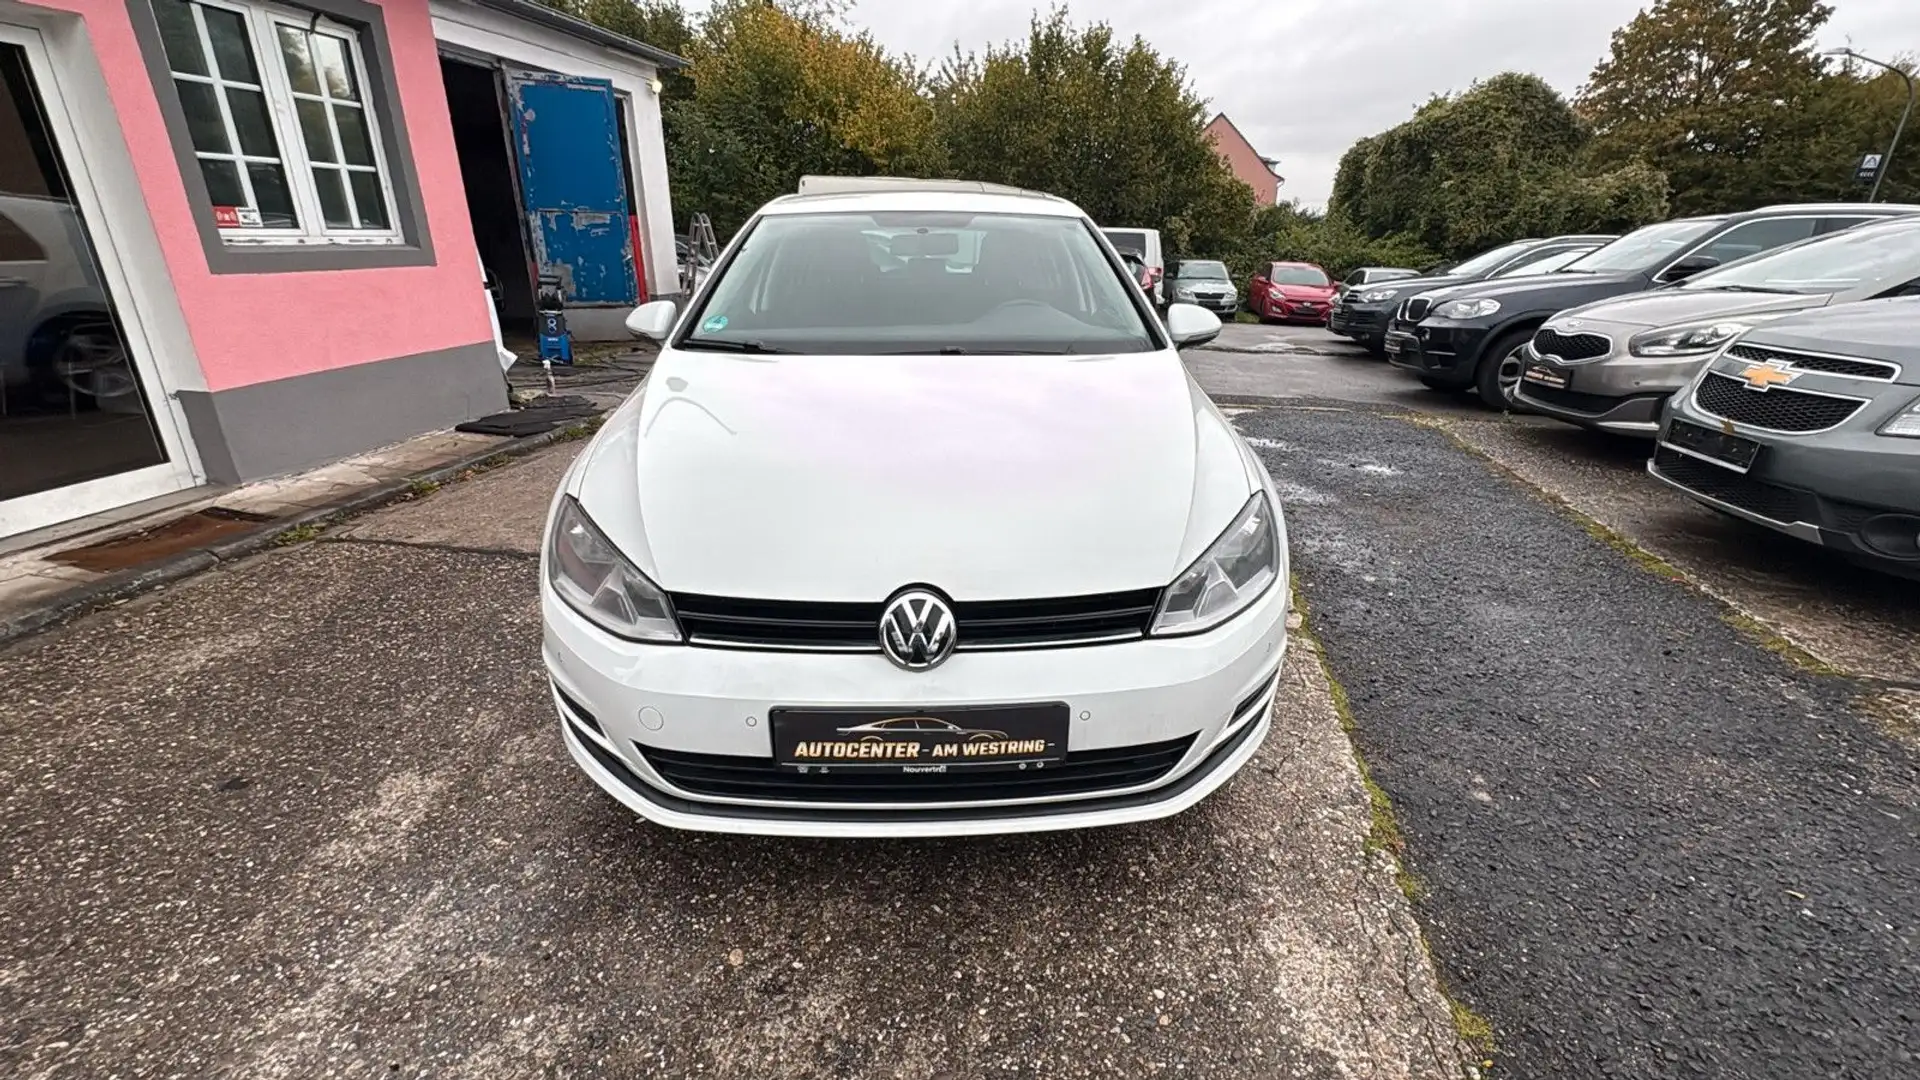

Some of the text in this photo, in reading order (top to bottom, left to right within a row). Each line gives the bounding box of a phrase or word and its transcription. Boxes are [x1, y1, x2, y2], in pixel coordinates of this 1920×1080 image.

[794, 741, 920, 758] AUTOCENTER
[932, 743, 957, 757] AM
[962, 739, 1045, 757] WESTRING
